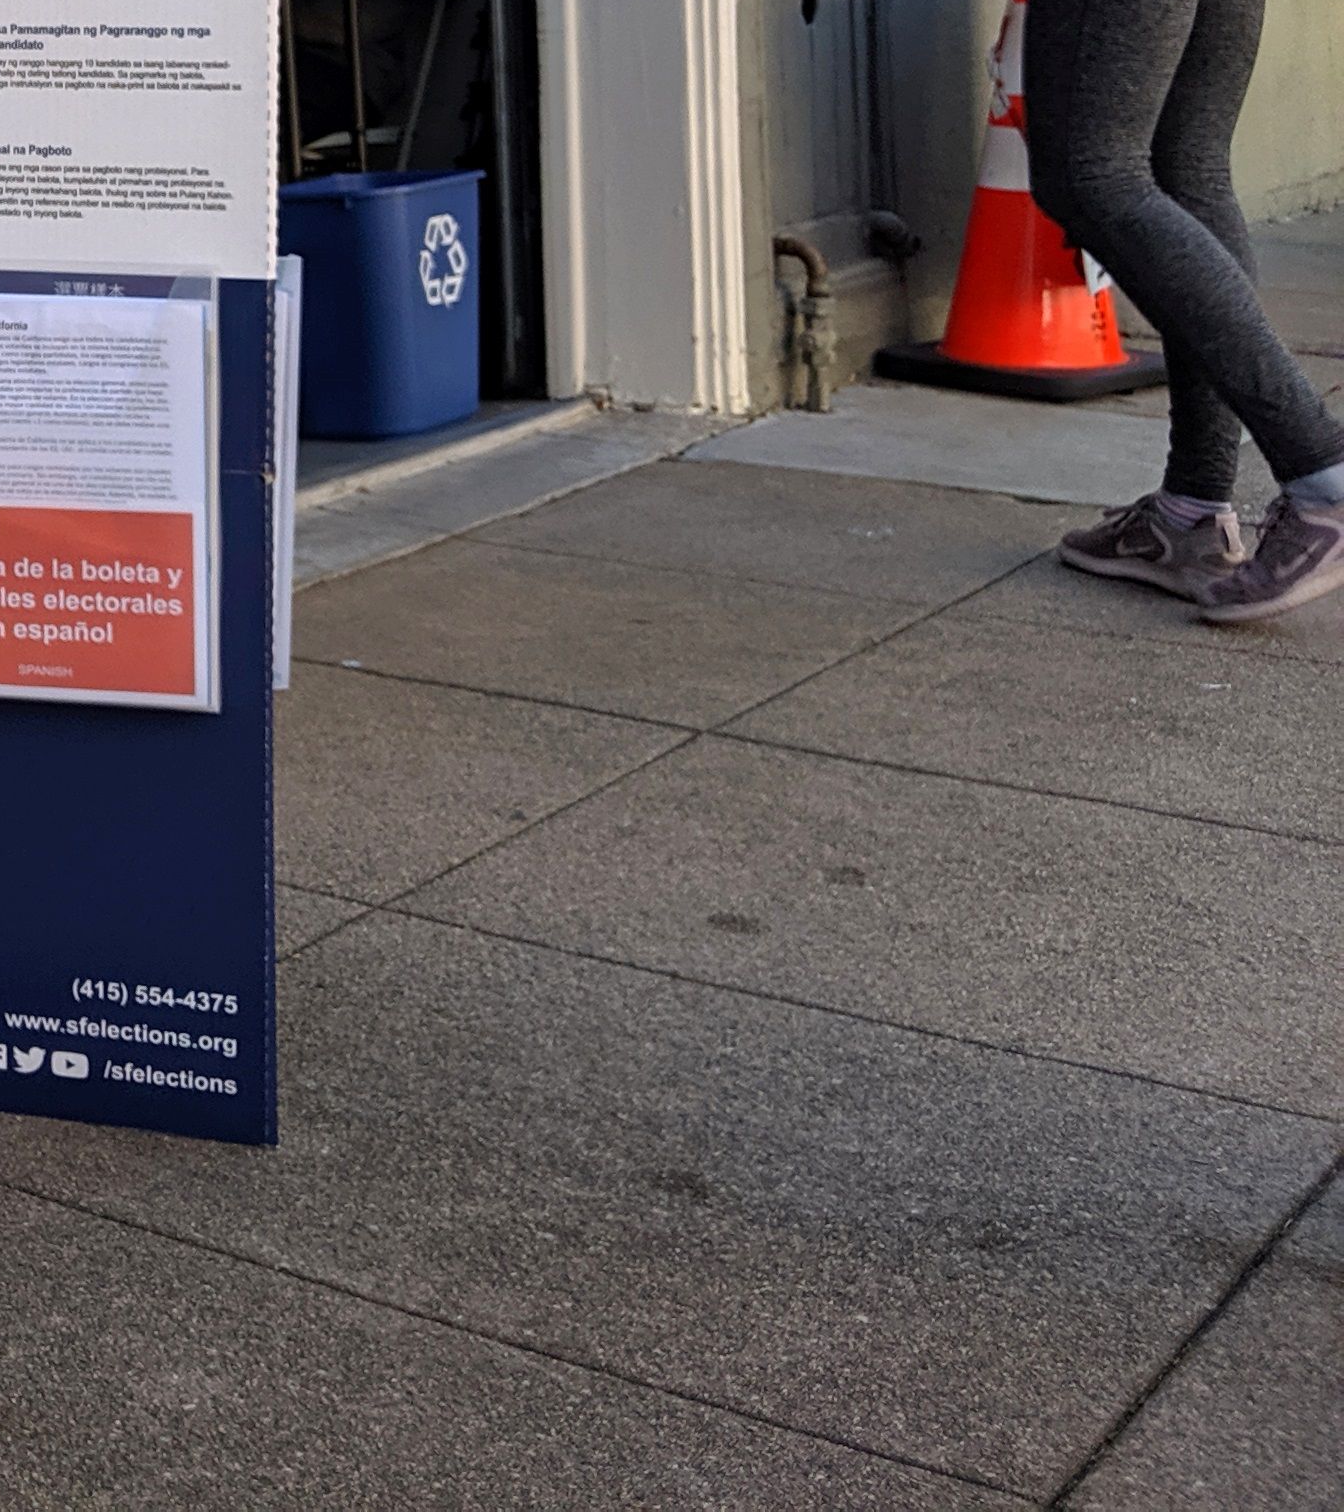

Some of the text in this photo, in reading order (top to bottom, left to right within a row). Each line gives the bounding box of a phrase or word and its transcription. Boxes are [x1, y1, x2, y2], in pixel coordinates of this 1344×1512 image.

[10, 24, 80, 38] Pamamagitan
[83, 26, 97, 38] ng
[100, 24, 168, 38] Pagraranggo
[171, 28, 185, 39] ng
[187, 28, 211, 39] mga
[13, 146, 26, 156] na
[29, 144, 72, 159] Pagboto
[14, 557, 44, 578] de
[52, 558, 73, 580] la
[82, 560, 160, 583] boleta
[168, 568, 183, 589] y
[44, 589, 183, 616] electorales
[14, 621, 113, 645] español
[18, 663, 73, 677] SPANISH
[73, 978, 237, 1014] (415) 554-4375
[5, 1013, 237, 1058] www.sfelections.org
[104, 1060, 237, 1095] /sfelections
